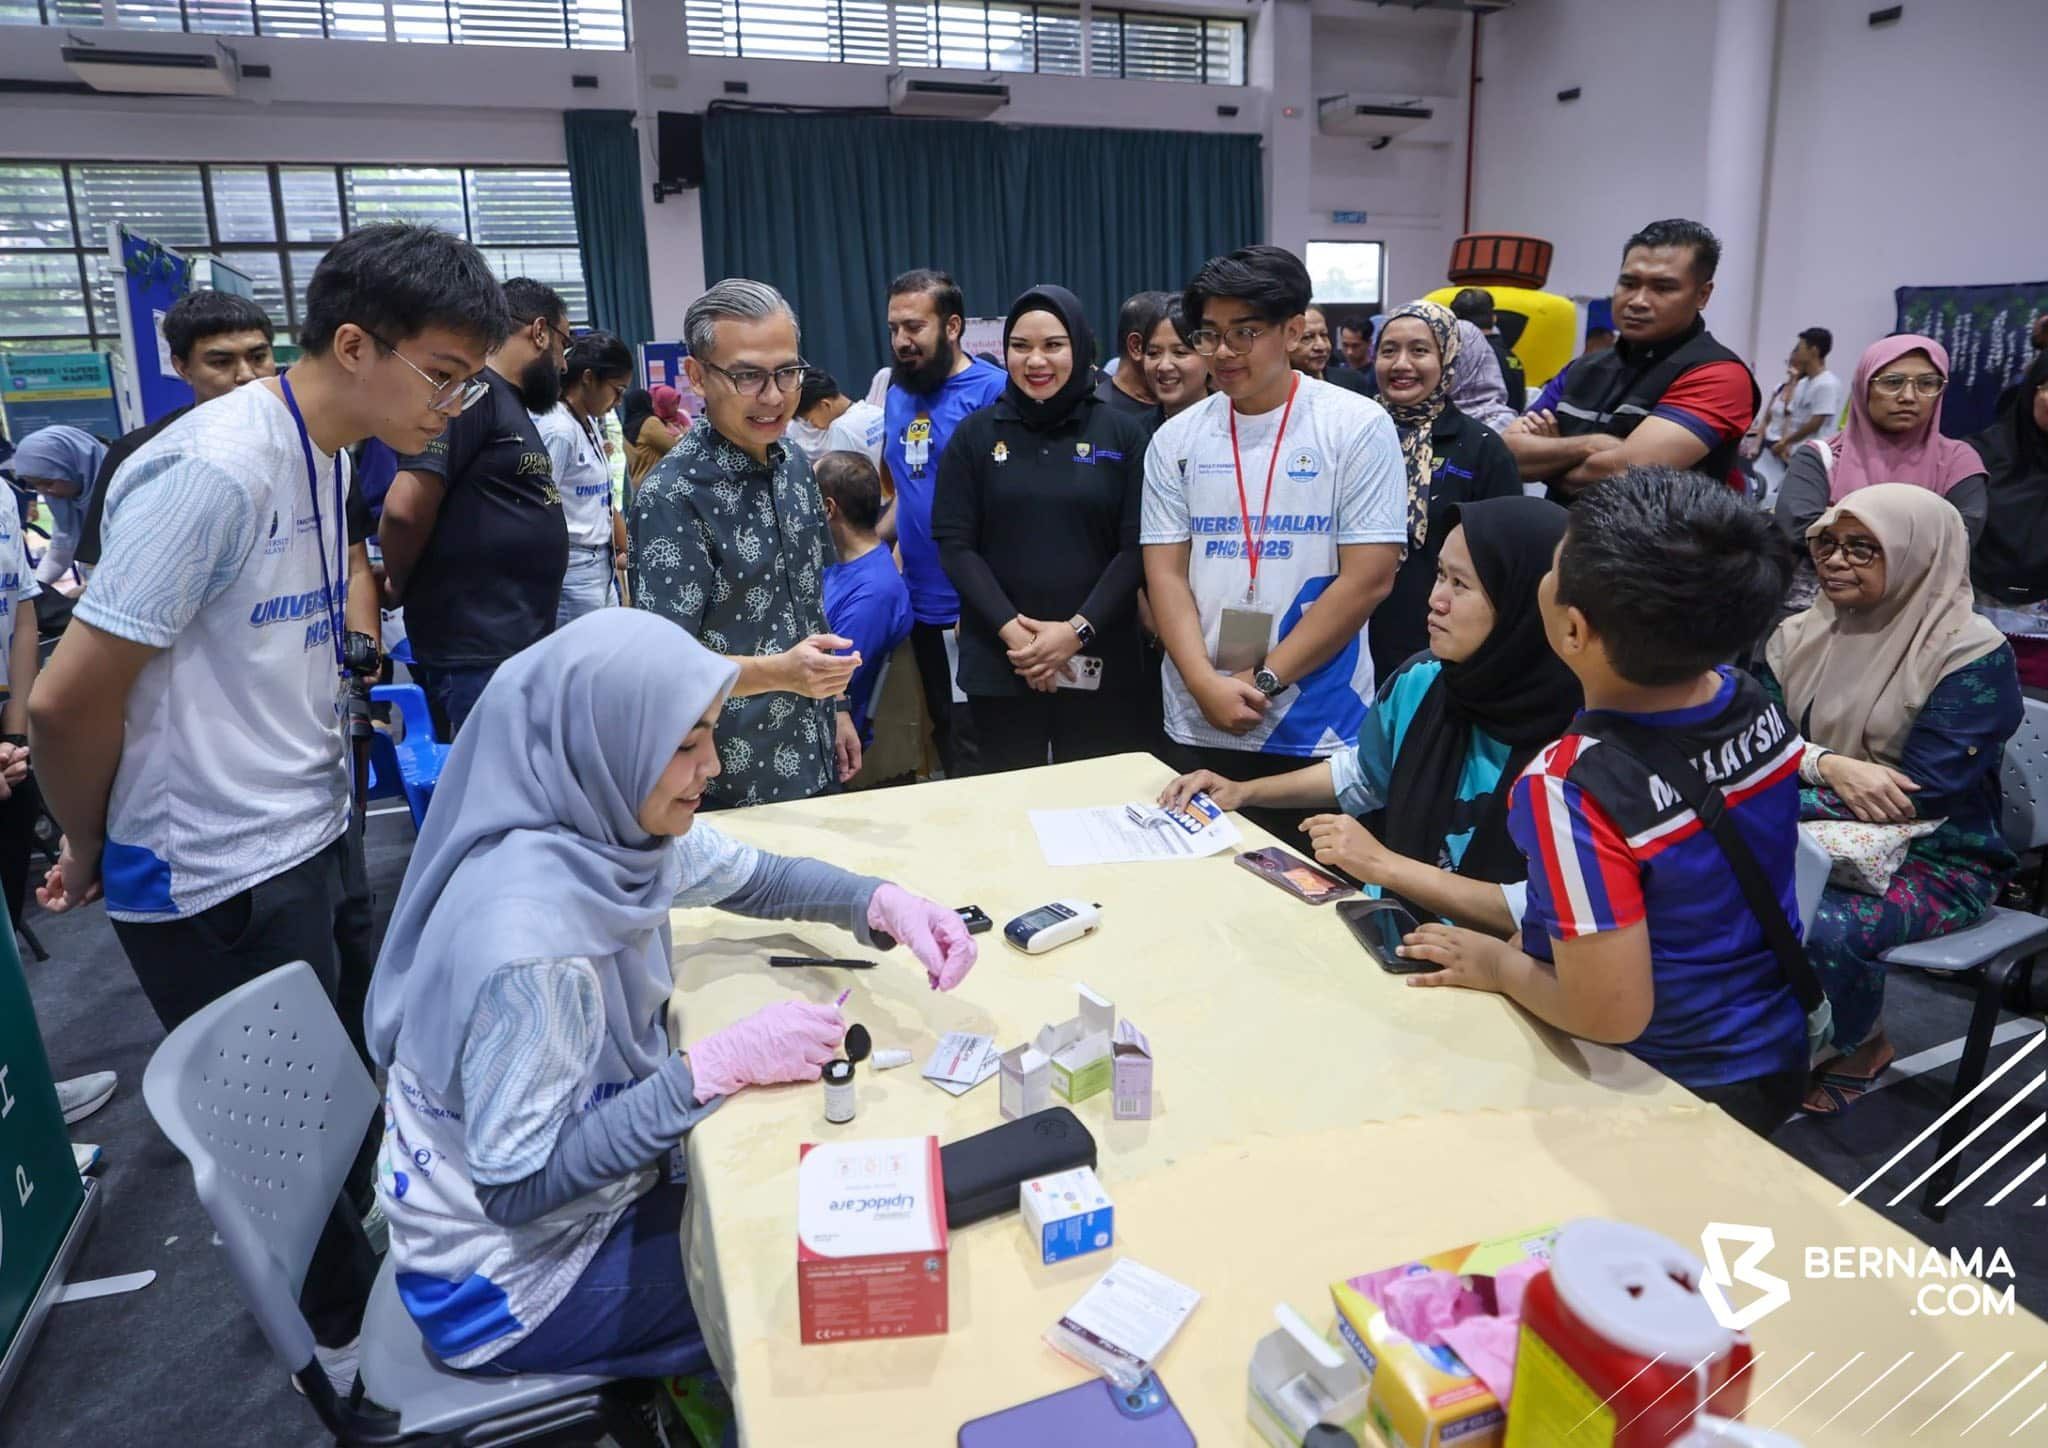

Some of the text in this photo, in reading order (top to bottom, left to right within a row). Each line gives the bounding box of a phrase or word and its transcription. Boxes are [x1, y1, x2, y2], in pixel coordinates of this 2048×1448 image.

[1204, 540, 1239, 559] PHC
[1648, 702, 1787, 813] MLAYSIA
[829, 1193, 915, 1213] LipidoCare
